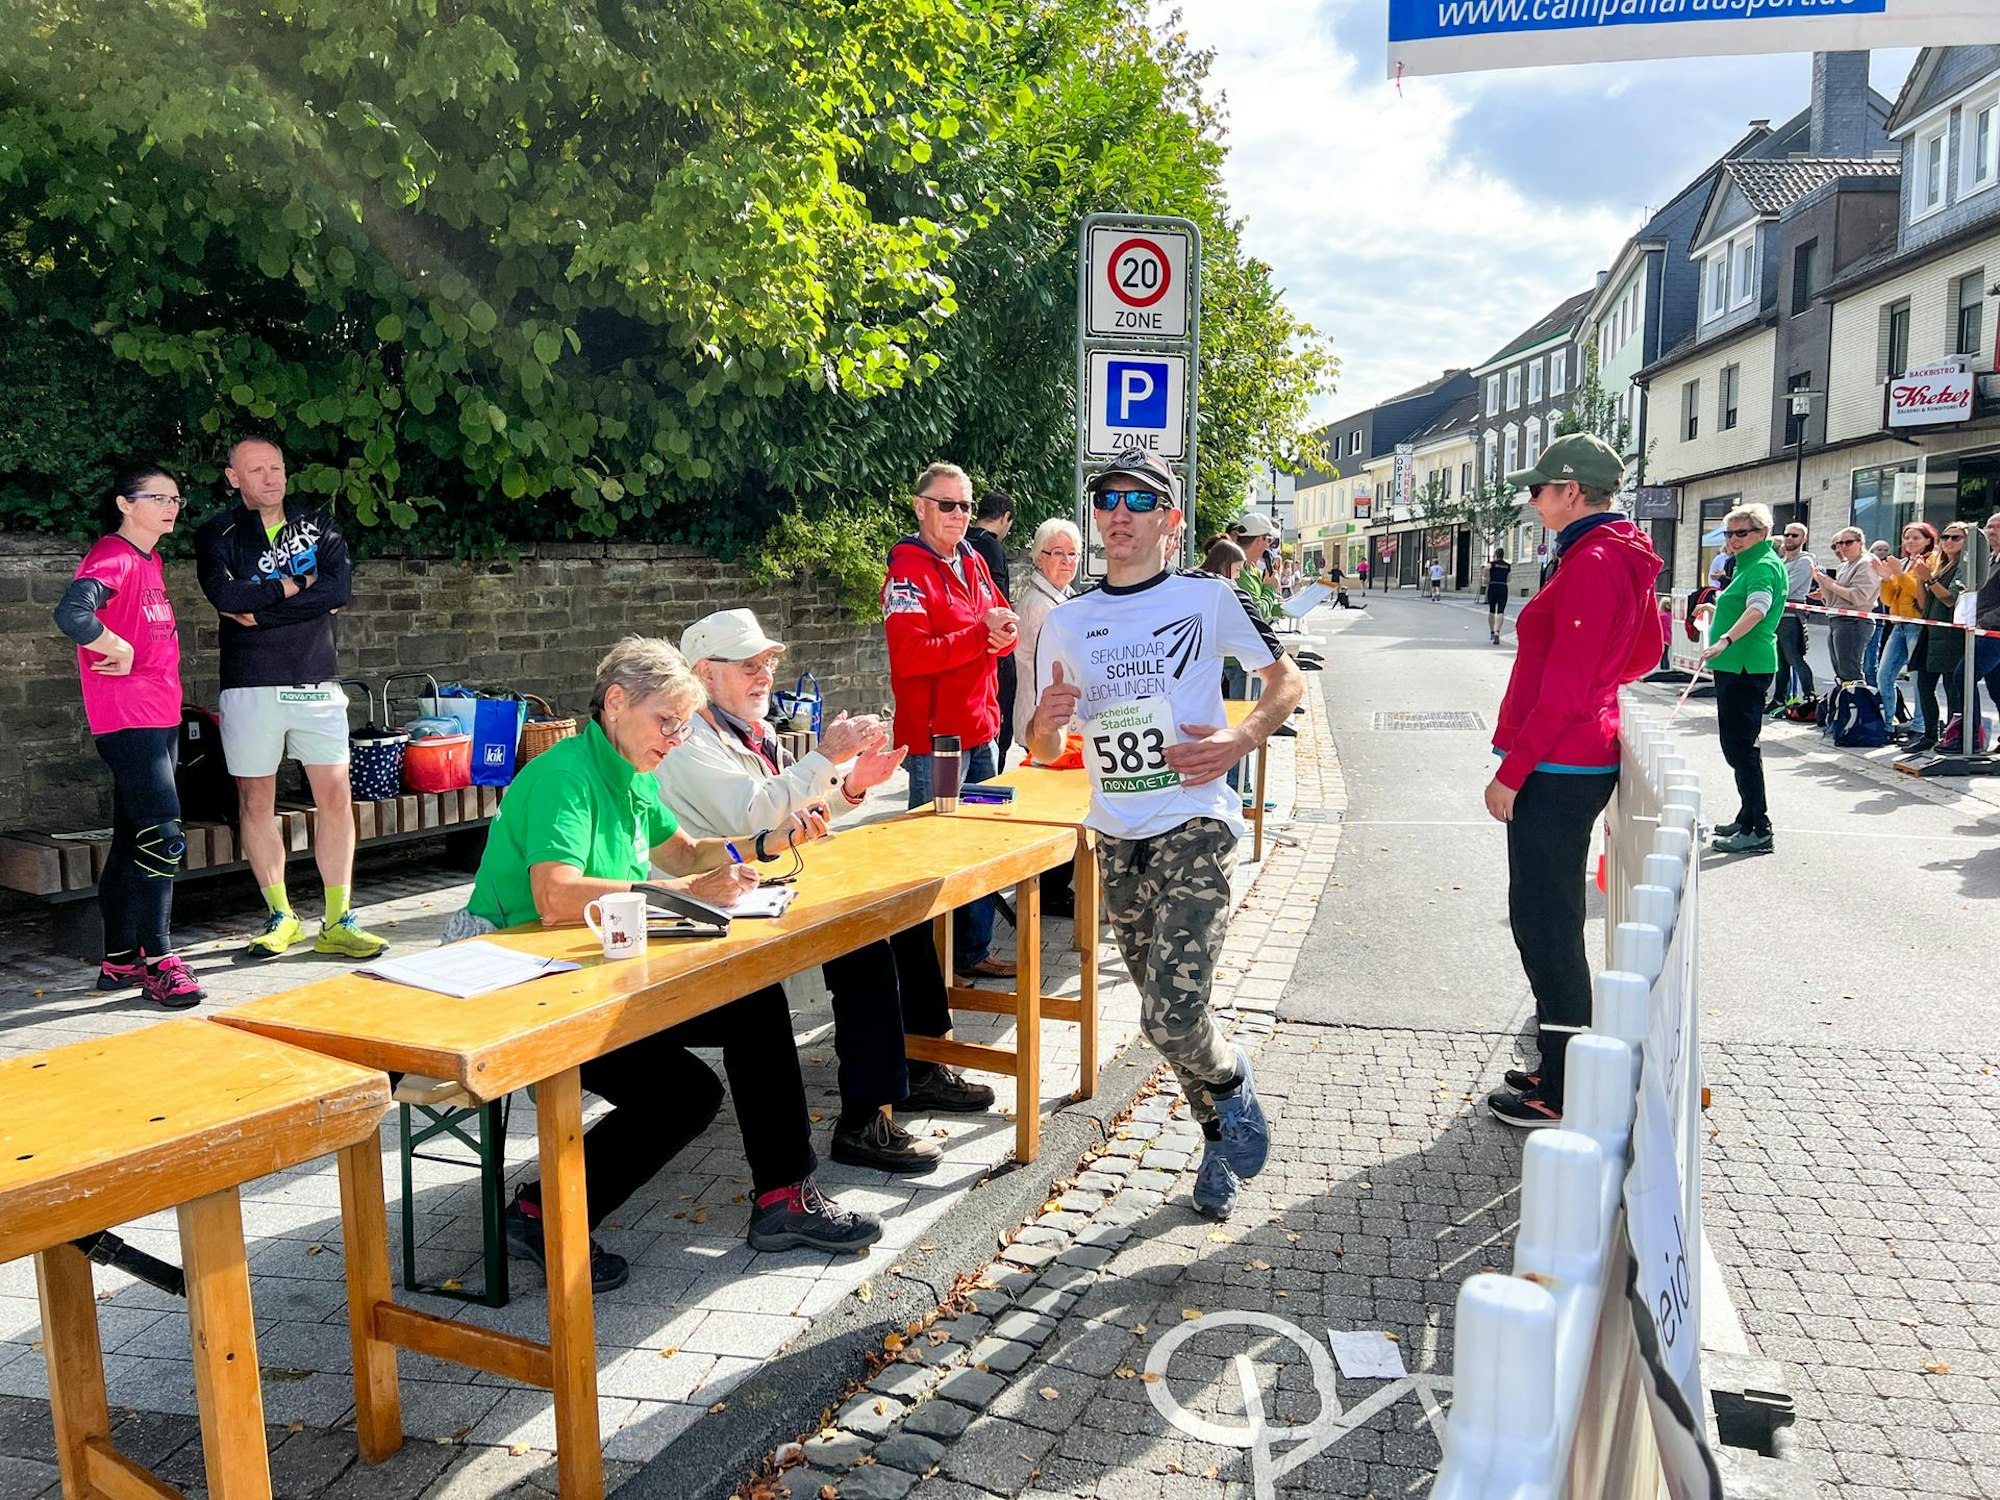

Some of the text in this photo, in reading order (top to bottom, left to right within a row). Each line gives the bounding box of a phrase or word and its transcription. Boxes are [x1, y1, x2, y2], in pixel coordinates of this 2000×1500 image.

[1122, 257, 1158, 289] 20
[1115, 311, 1163, 329] ZONE
[1909, 367, 1955, 378] BACKBISTRO
[1120, 369, 1155, 420] P
[1892, 385, 1971, 408] Kretzer
[1112, 433, 1159, 450] ZONE
[1085, 628, 1109, 639] JAKO
[1091, 641, 1165, 665] SEKUNDAR
[1106, 659, 1165, 680] SCHULE
[1086, 678, 1165, 702] LEICHLINGEN
[1100, 713, 1154, 731] Stadtlauf
[1093, 728, 1167, 774] 583
